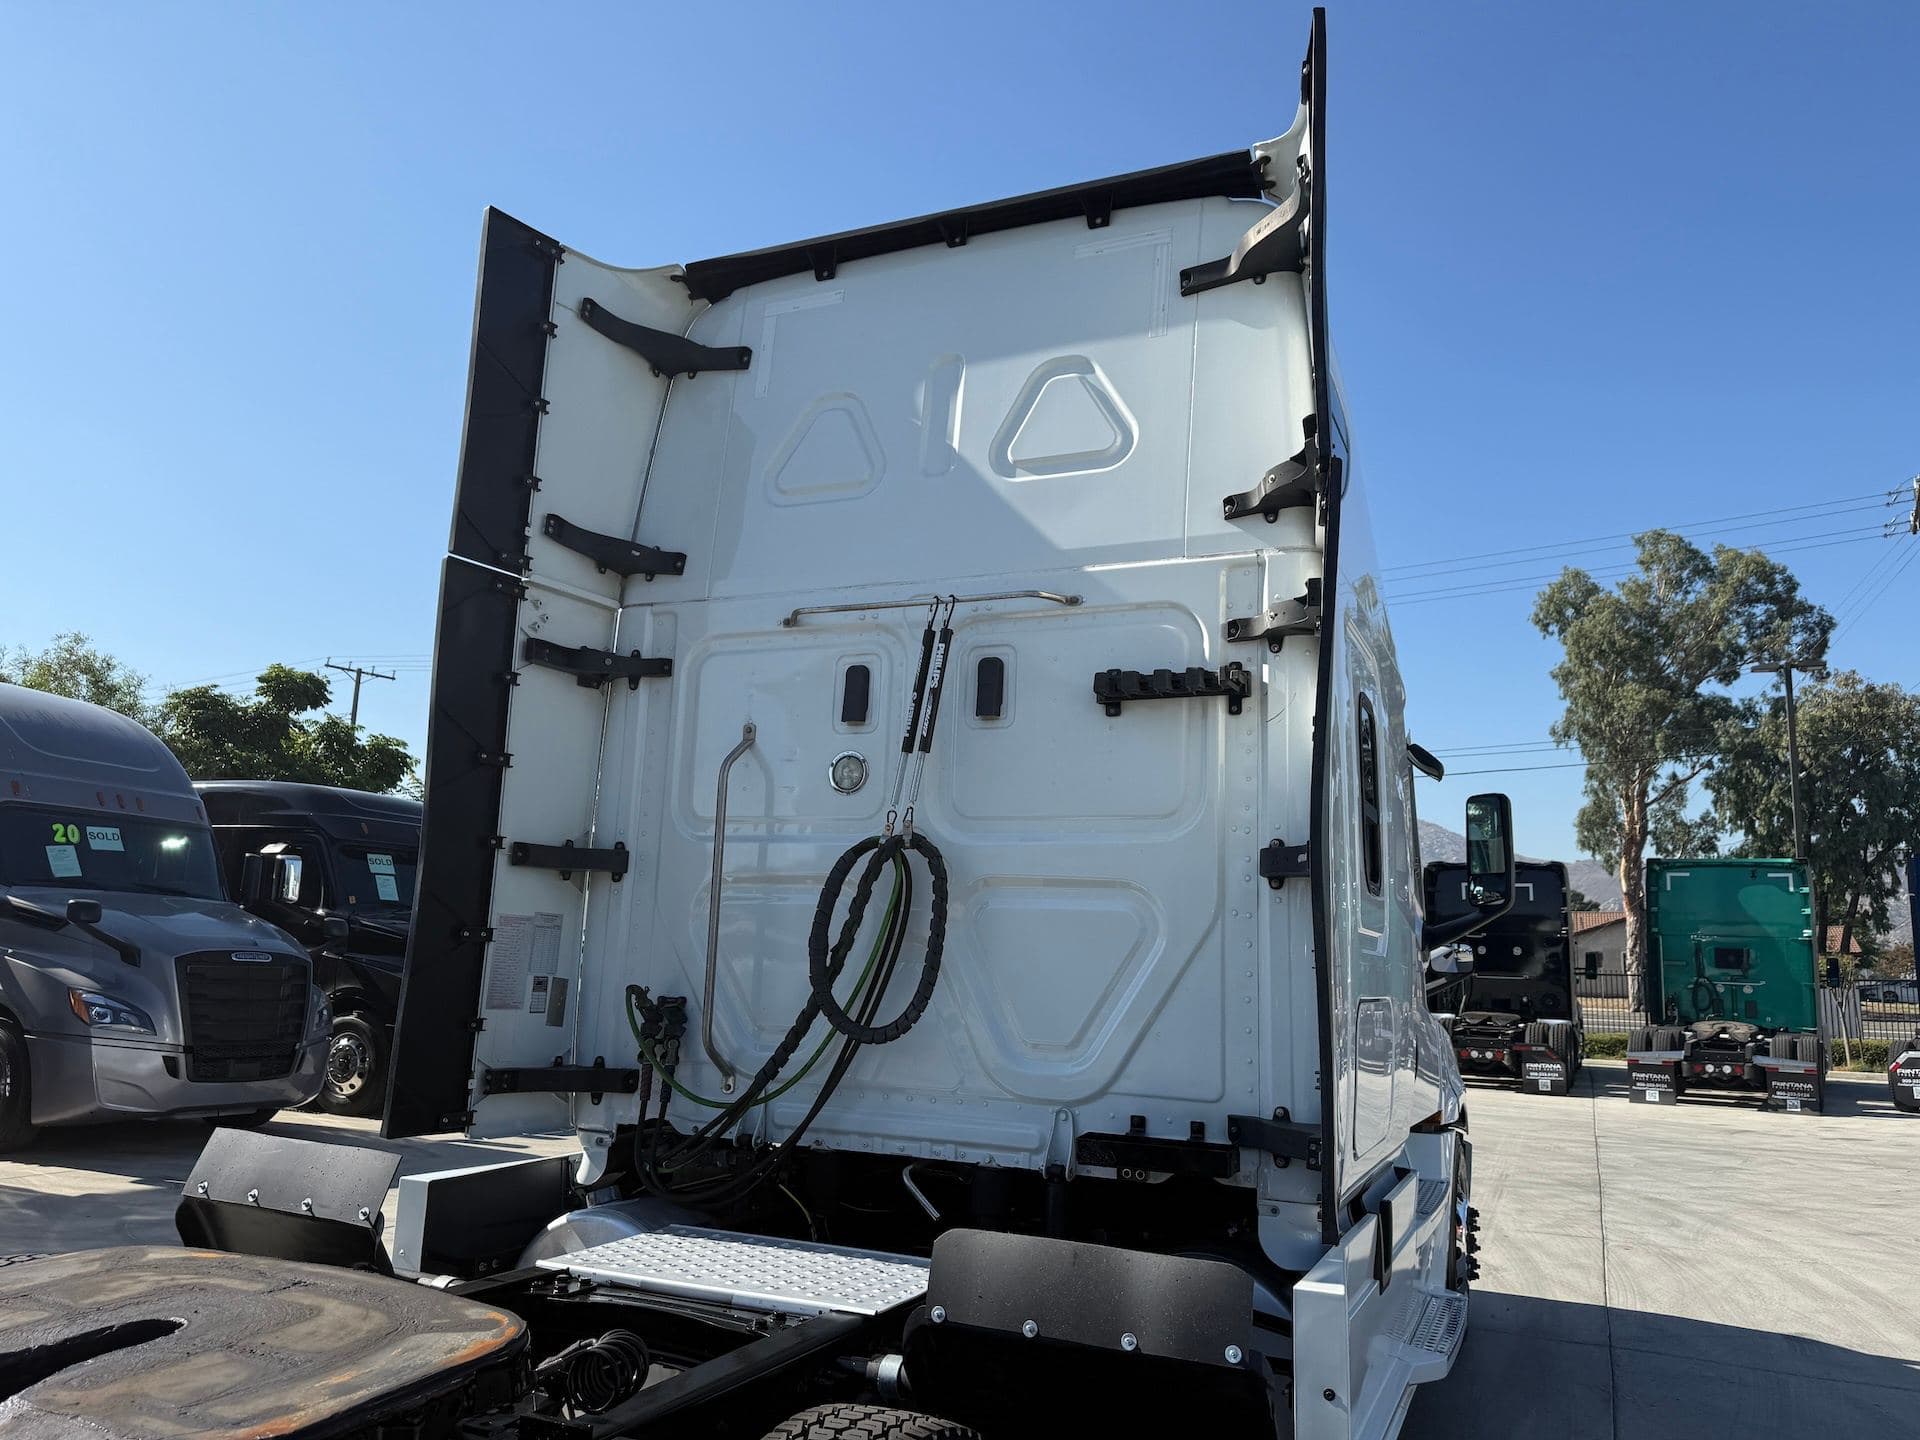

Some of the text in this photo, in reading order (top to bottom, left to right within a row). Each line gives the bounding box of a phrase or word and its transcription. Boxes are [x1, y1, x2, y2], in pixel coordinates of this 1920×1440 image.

[930, 642, 946, 689] PHILLIPS
[52, 823, 80, 844] 20
[88, 831, 120, 842] SOLD
[369, 857, 392, 866] SOLD
